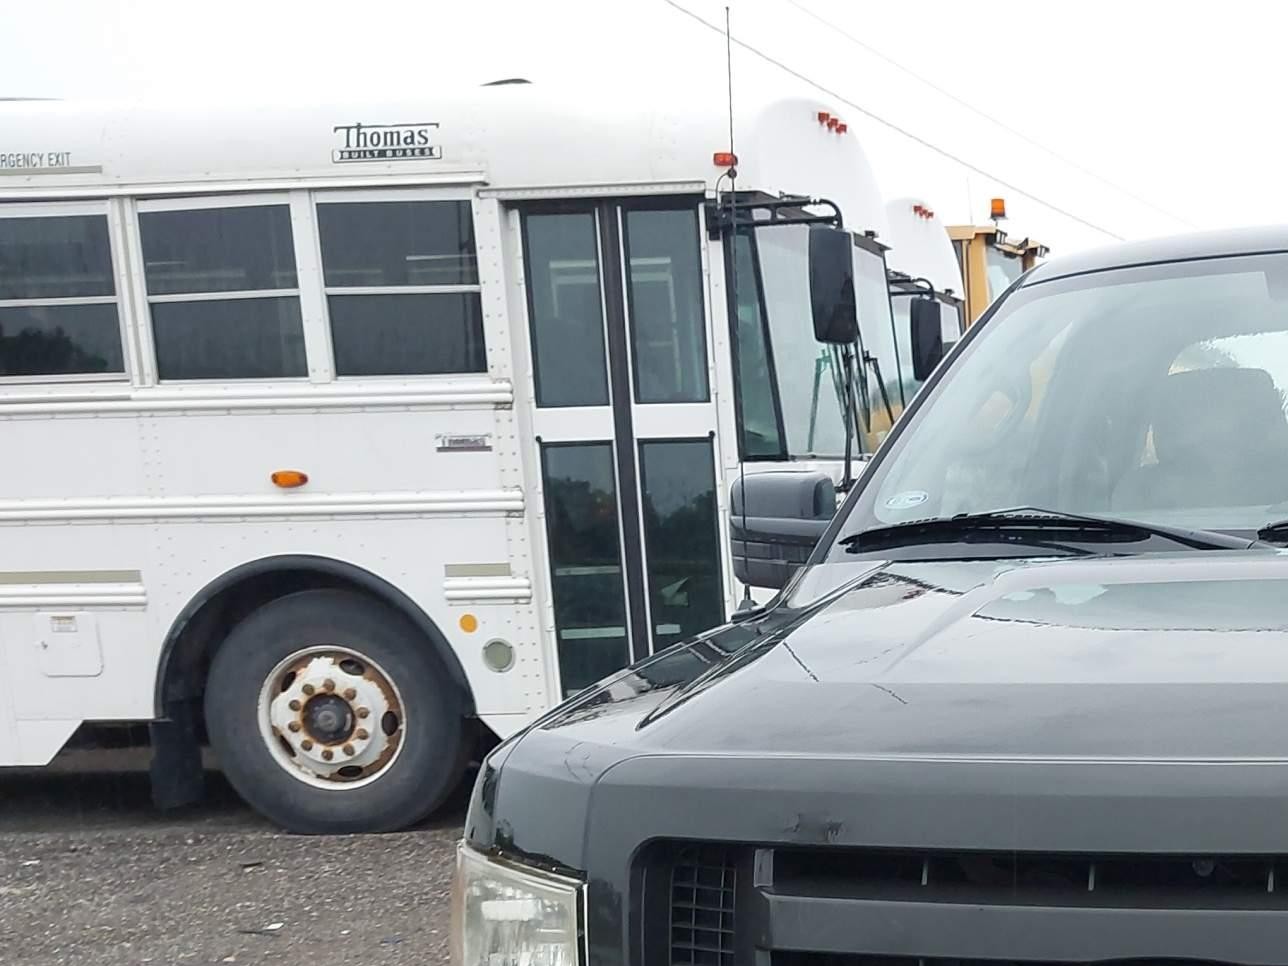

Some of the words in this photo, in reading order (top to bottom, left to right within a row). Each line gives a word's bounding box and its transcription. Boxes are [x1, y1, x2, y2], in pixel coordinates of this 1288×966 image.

[335, 122, 439, 148] Thomas
[0, 152, 44, 168] RGENCY
[48, 151, 71, 167] EXIT
[342, 150, 379, 159] BUILT
[386, 147, 431, 158] BUSES
